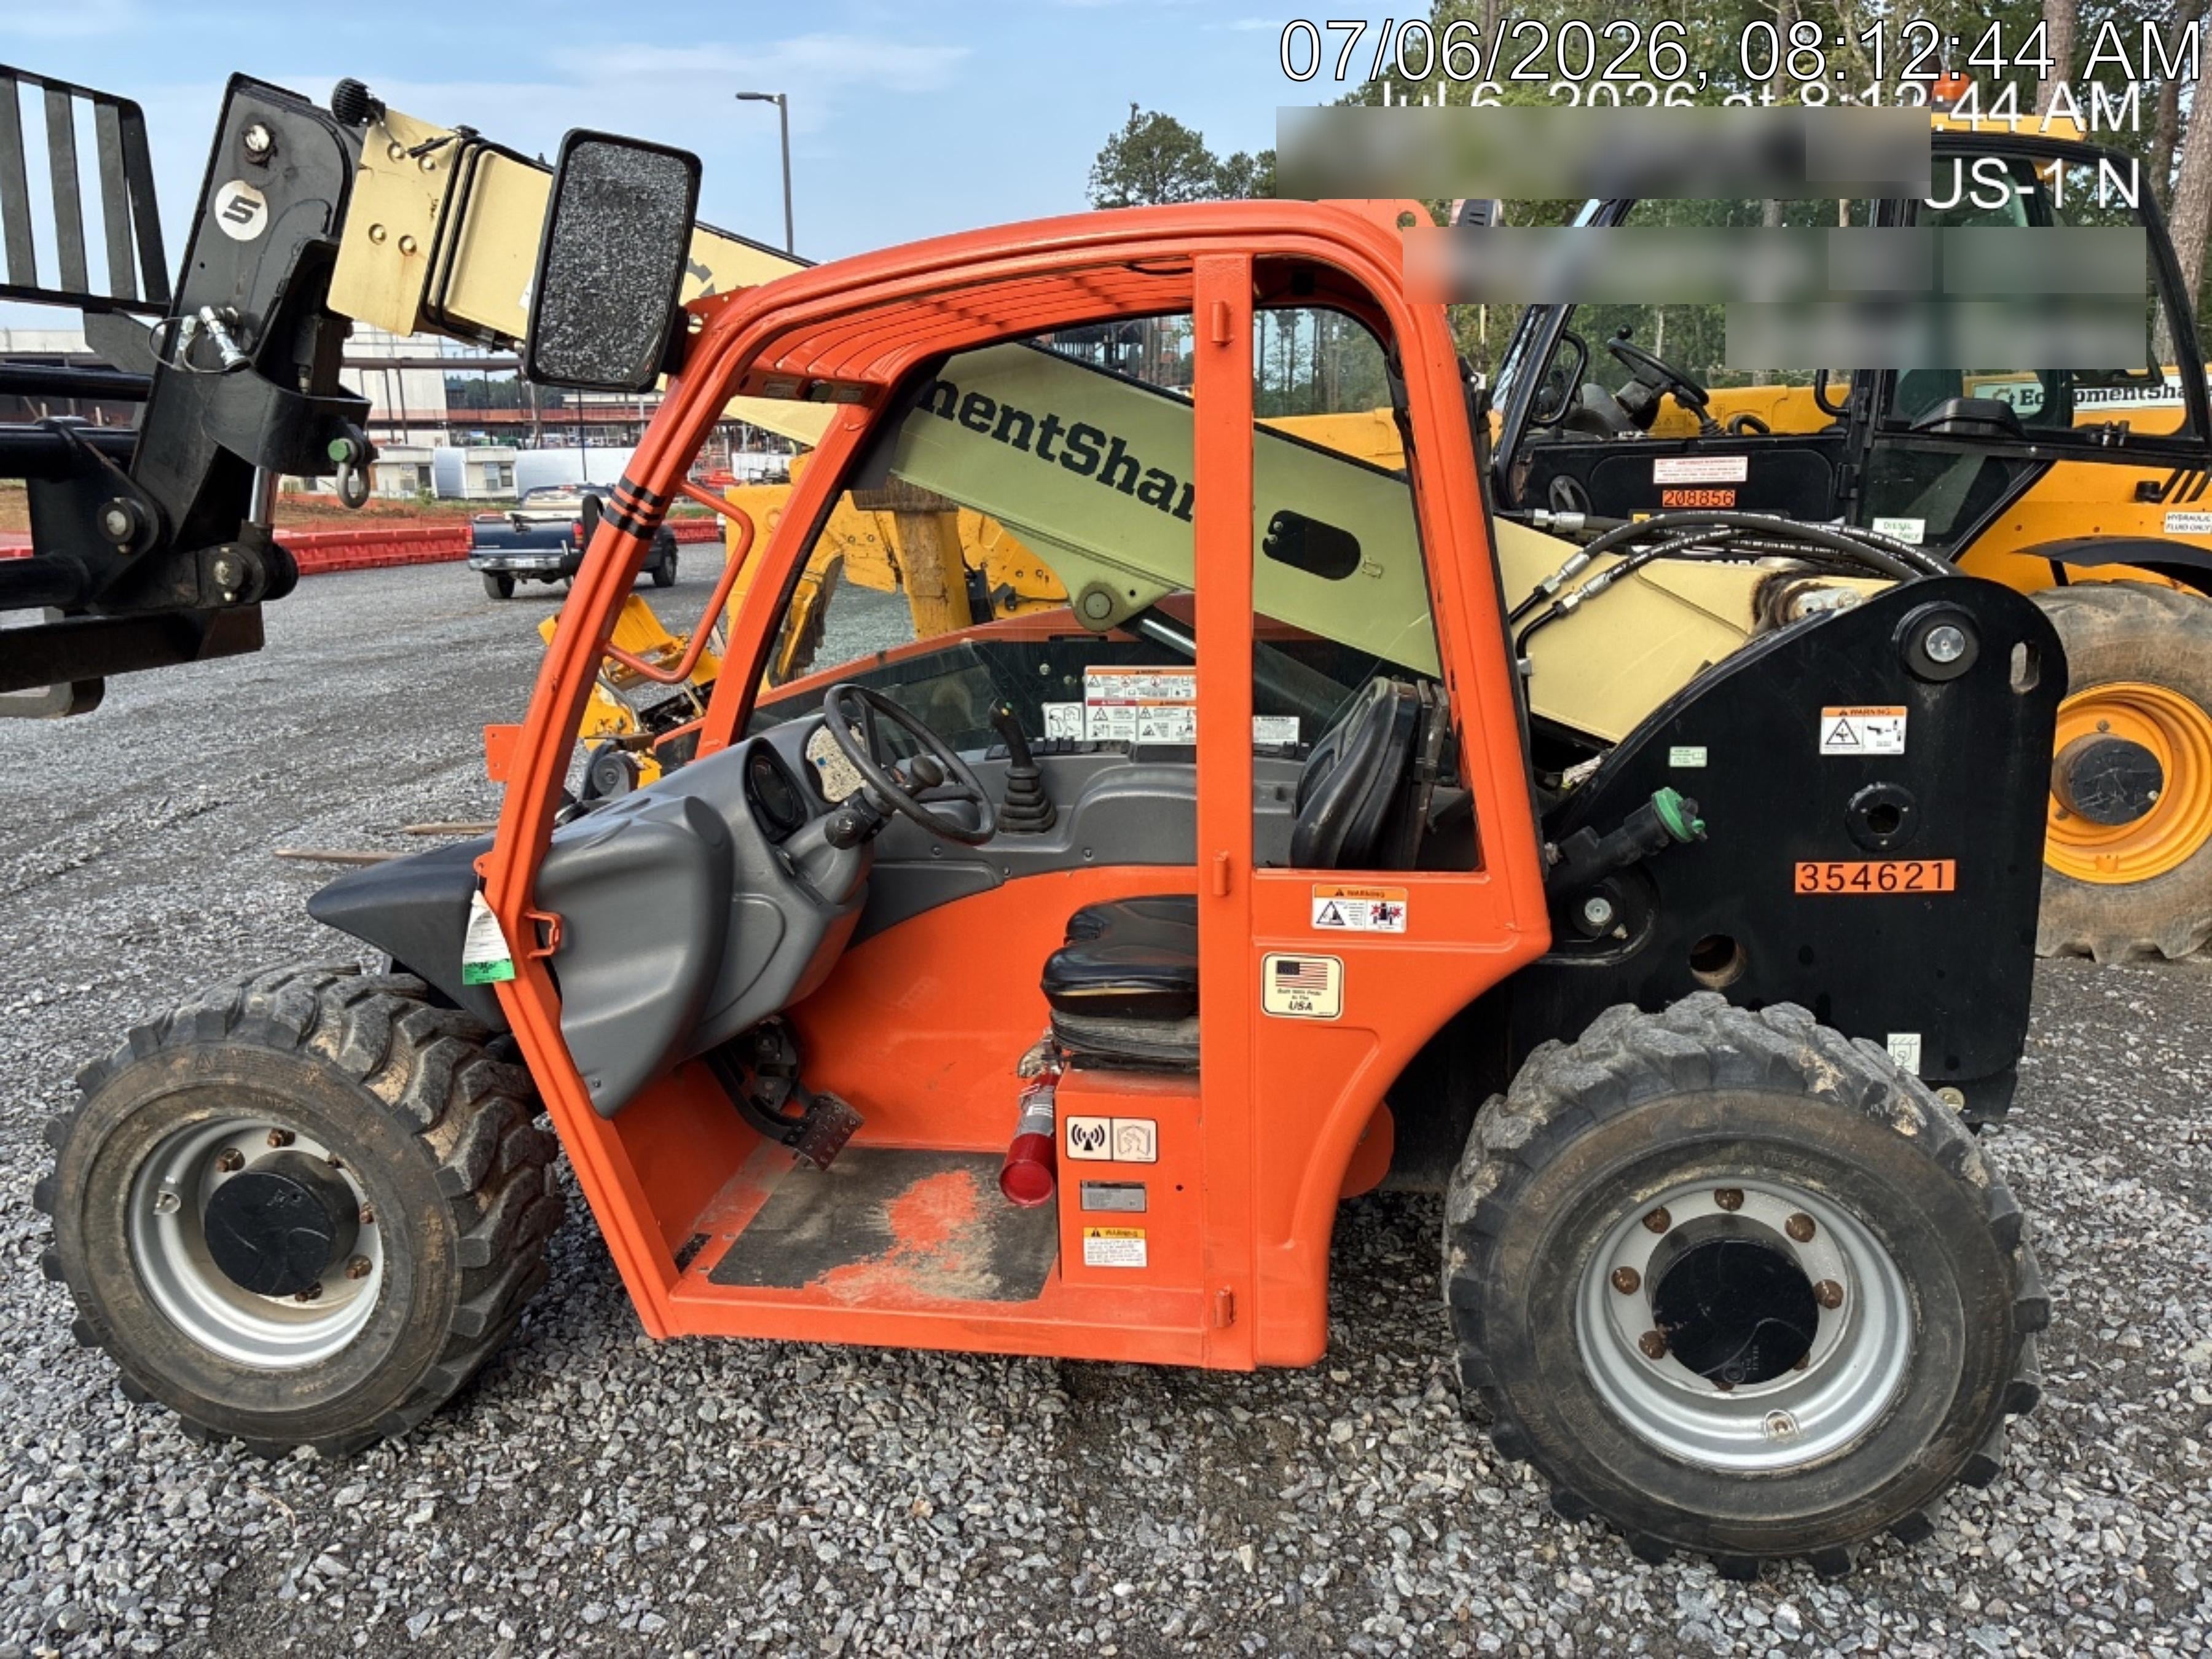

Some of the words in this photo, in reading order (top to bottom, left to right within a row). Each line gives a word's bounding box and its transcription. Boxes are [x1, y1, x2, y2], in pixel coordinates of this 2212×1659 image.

[1664, 491, 1734, 506] 208856
[1800, 862, 1943, 892] 354621
[1288, 1000, 1312, 1011] USA
